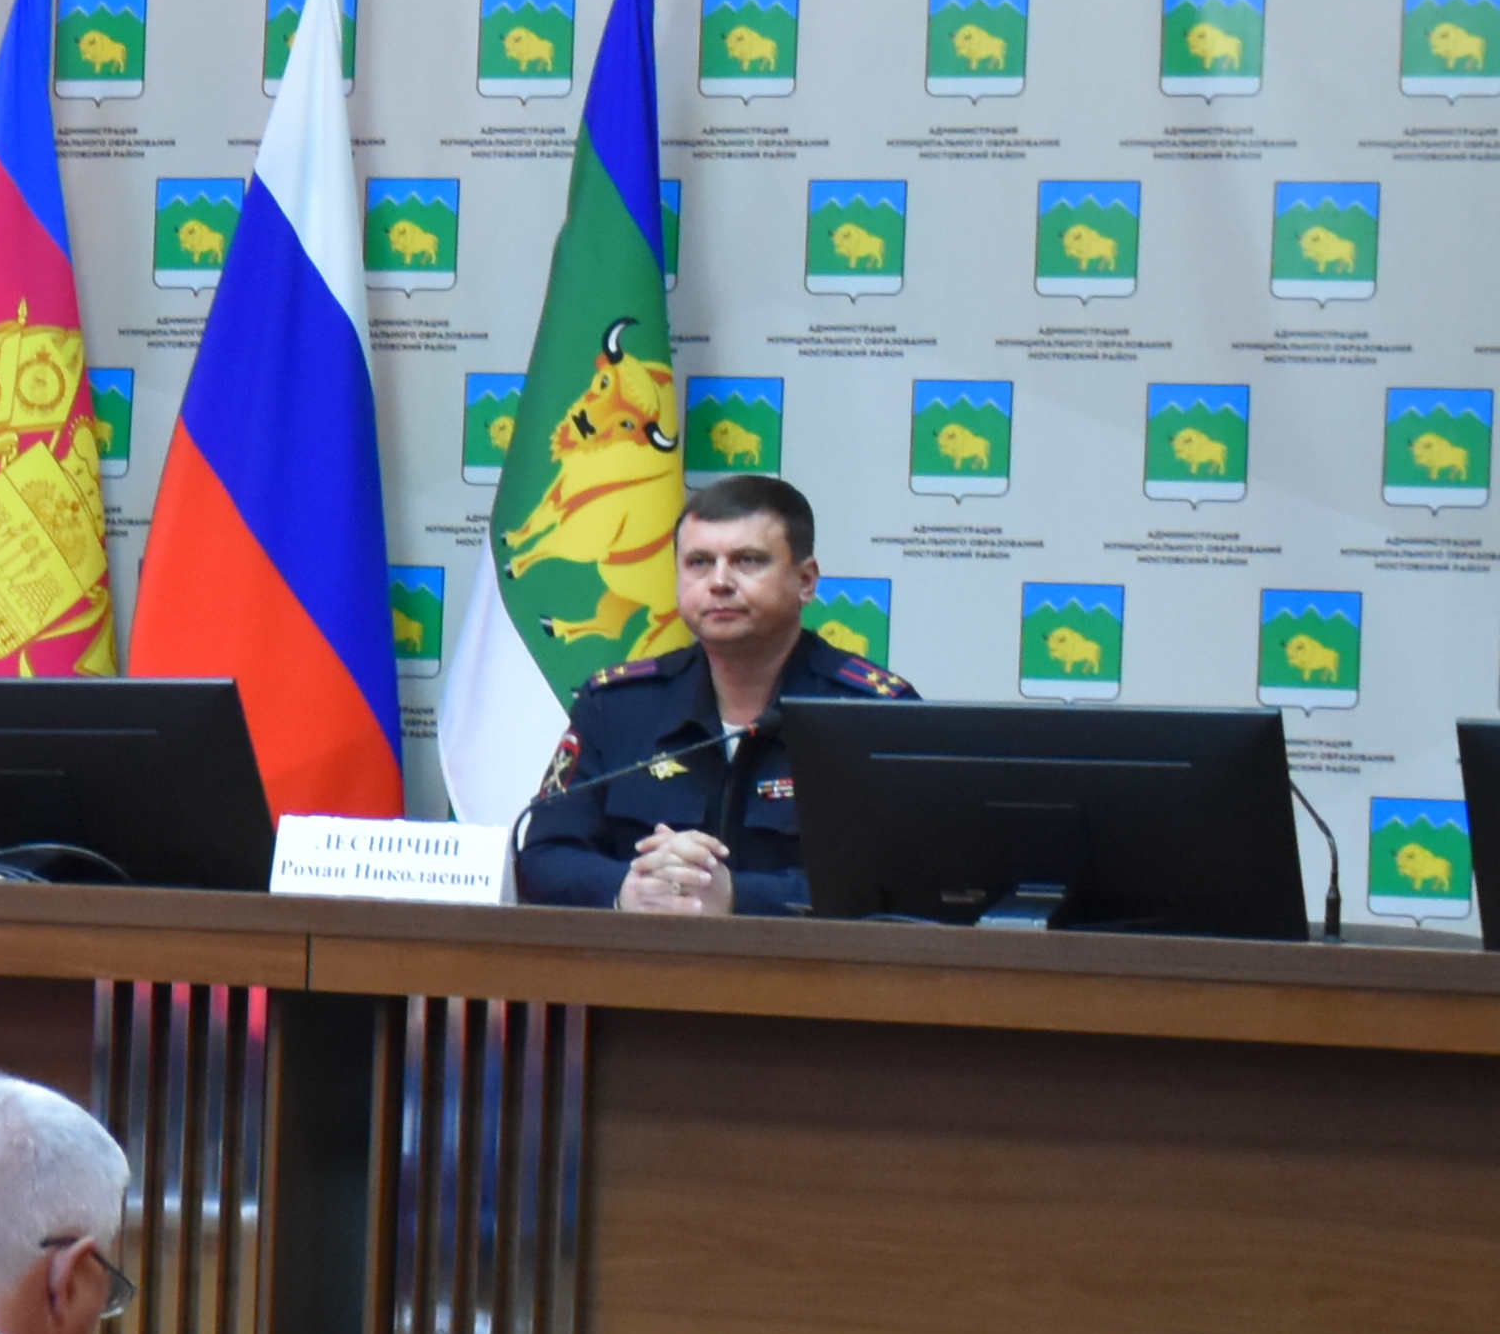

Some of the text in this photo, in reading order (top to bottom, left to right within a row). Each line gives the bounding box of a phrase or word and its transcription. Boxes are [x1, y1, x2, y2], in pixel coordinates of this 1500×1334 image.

[316, 834, 460, 856] ЛЕСНИЧИЙ
[280, 860, 490, 887] Роман Николаевич
